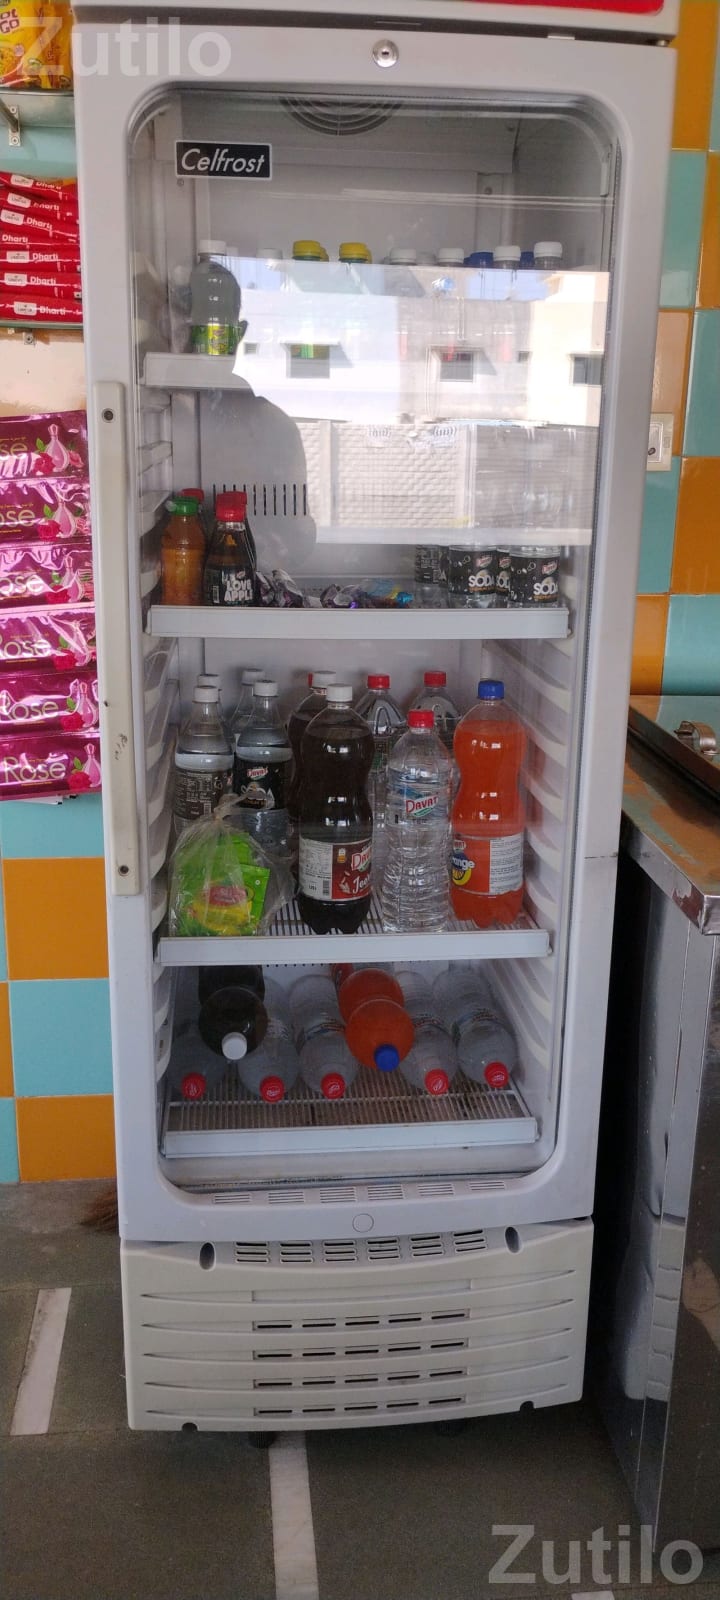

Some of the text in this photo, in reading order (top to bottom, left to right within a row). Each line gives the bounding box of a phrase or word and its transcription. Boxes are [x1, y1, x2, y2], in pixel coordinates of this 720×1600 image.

[181, 148, 265, 173] Celfrost
[26, 217, 53, 230] Dharti
[2, 233, 28, 243] Dharti
[32, 252, 59, 262] Dharti
[30, 276, 57, 286] Dharti
[40, 306, 66, 316] Dharti
[0, 442, 28, 459] se
[0, 574, 44, 596] ose
[0, 634, 51, 658] ose
[4, 756, 66, 784] Rose
